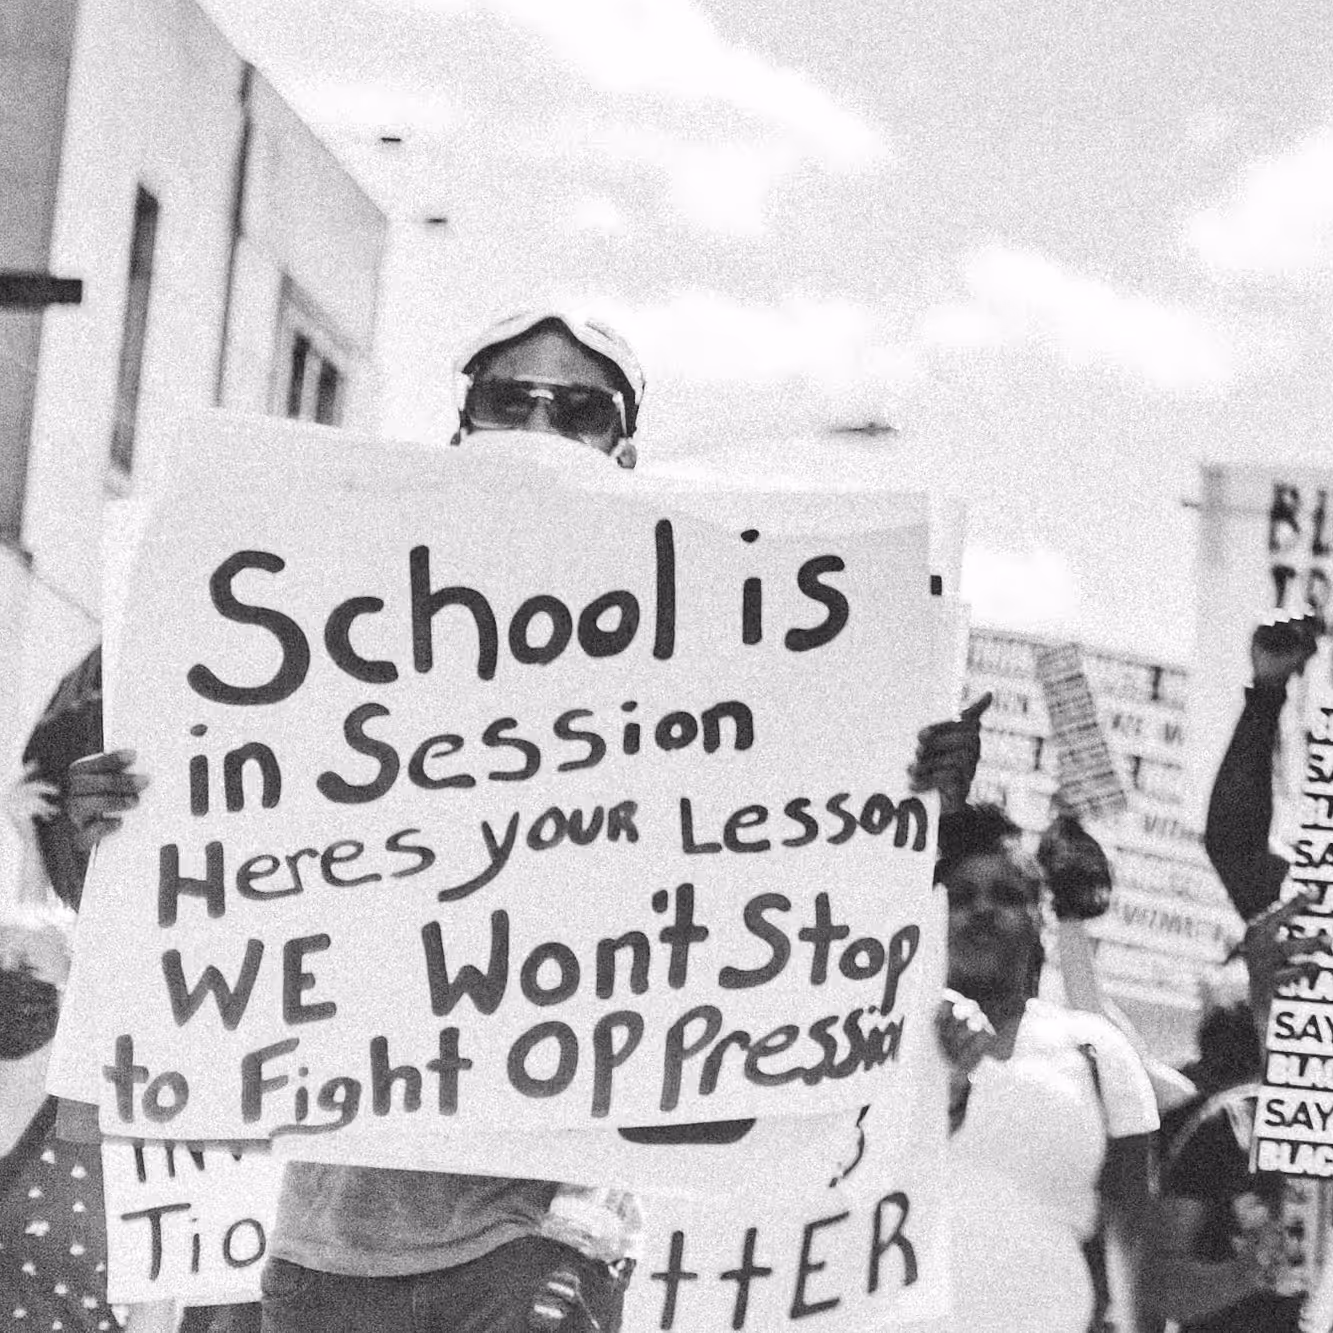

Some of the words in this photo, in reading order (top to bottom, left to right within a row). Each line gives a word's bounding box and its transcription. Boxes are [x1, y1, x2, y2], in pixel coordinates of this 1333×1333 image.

[187, 519, 675, 706] School
[741, 528, 850, 653] is
[189, 723, 283, 818] in
[316, 700, 754, 804] Session
[157, 828, 436, 928] Heres
[680, 793, 928, 854] Lesson
[161, 933, 337, 1031] WE
[421, 883, 709, 1016] Won't
[718, 891, 920, 1017] Stop
[104, 1033, 189, 1124] to
[241, 1026, 473, 1138] Fight
